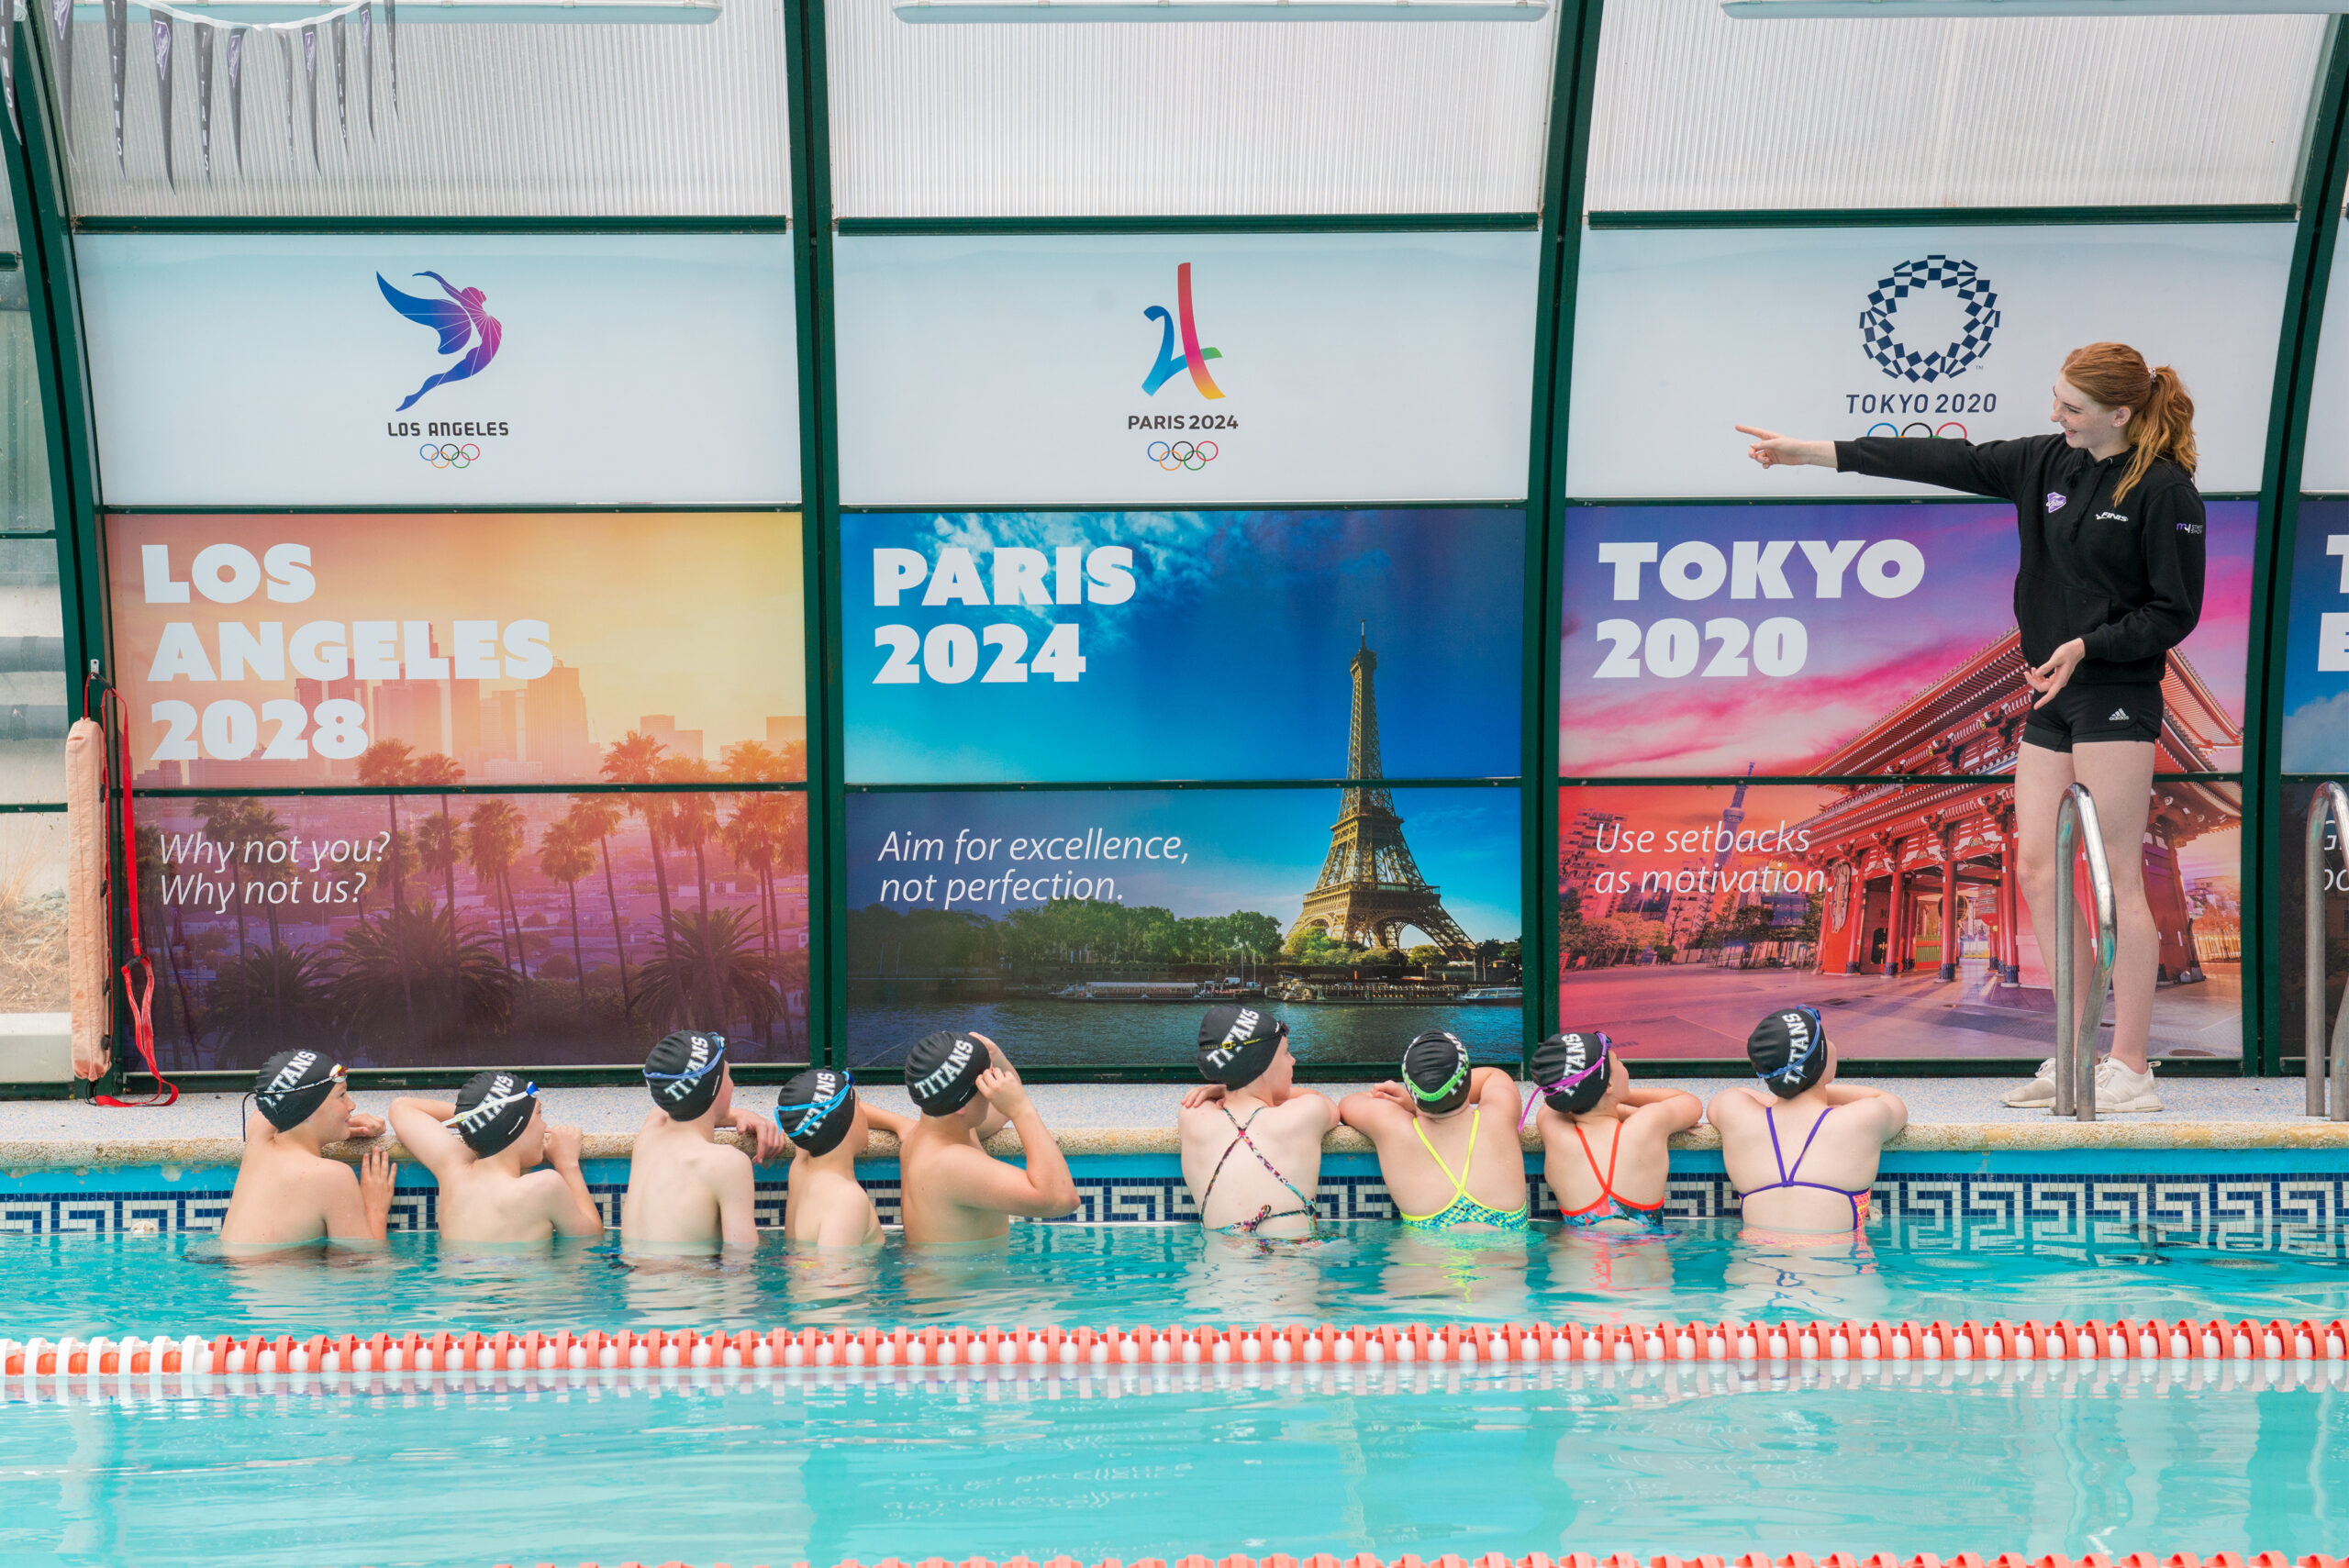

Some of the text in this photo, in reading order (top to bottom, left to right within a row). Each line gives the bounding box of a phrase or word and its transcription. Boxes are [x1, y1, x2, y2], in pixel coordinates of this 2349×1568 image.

[1128, 415, 1239, 429] PARIS 2024
[1846, 393, 1997, 414] TOKYO 2020
[387, 422, 509, 437] LOS ANGELES
[141, 543, 316, 604] LOS
[874, 546, 1136, 606] PARIS
[1598, 539, 1925, 601] TOKYO
[147, 619, 552, 682] ANGELES
[872, 624, 1086, 684] 2024
[1592, 617, 1808, 678] 2020
[150, 699, 369, 761] 2028
[160, 831, 391, 873] Why not you?
[877, 828, 1189, 864] Aim for excellence,
[1596, 820, 1811, 853] Use setbacks
[161, 872, 367, 915] Why not us?
[880, 869, 1123, 910] not perfection.
[1595, 862, 1833, 894] as motivation.
[914, 1040, 974, 1099] TITANS
